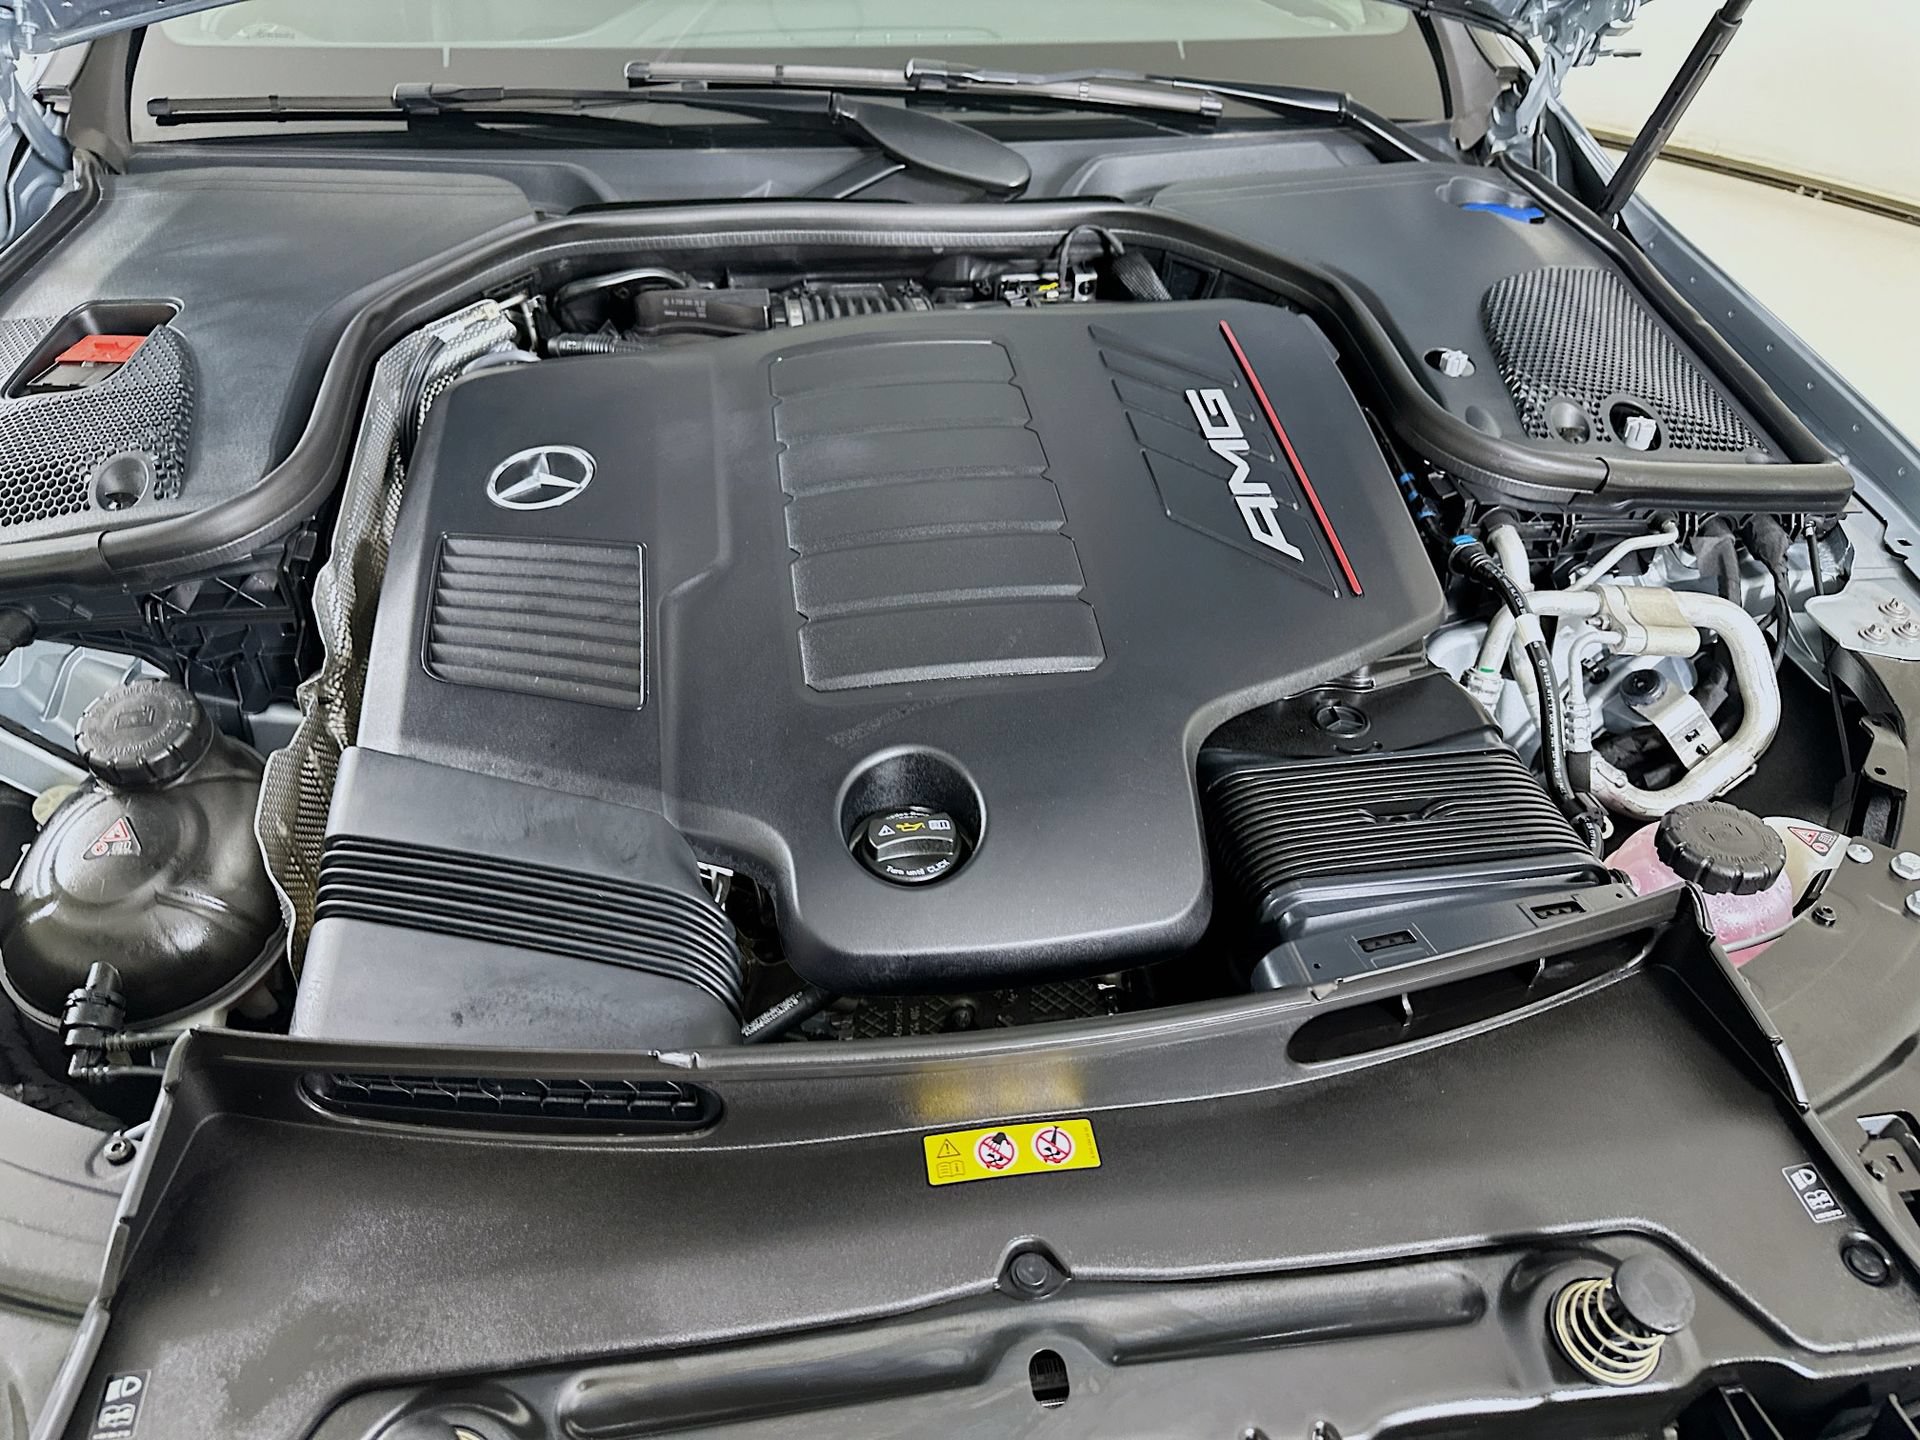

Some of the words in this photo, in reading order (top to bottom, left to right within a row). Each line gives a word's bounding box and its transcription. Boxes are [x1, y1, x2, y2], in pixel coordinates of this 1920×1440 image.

[1185, 389, 1304, 562] AMG
[886, 865, 905, 875] Turn
[906, 868, 925, 876] until
[926, 858, 950, 873] CLICK
